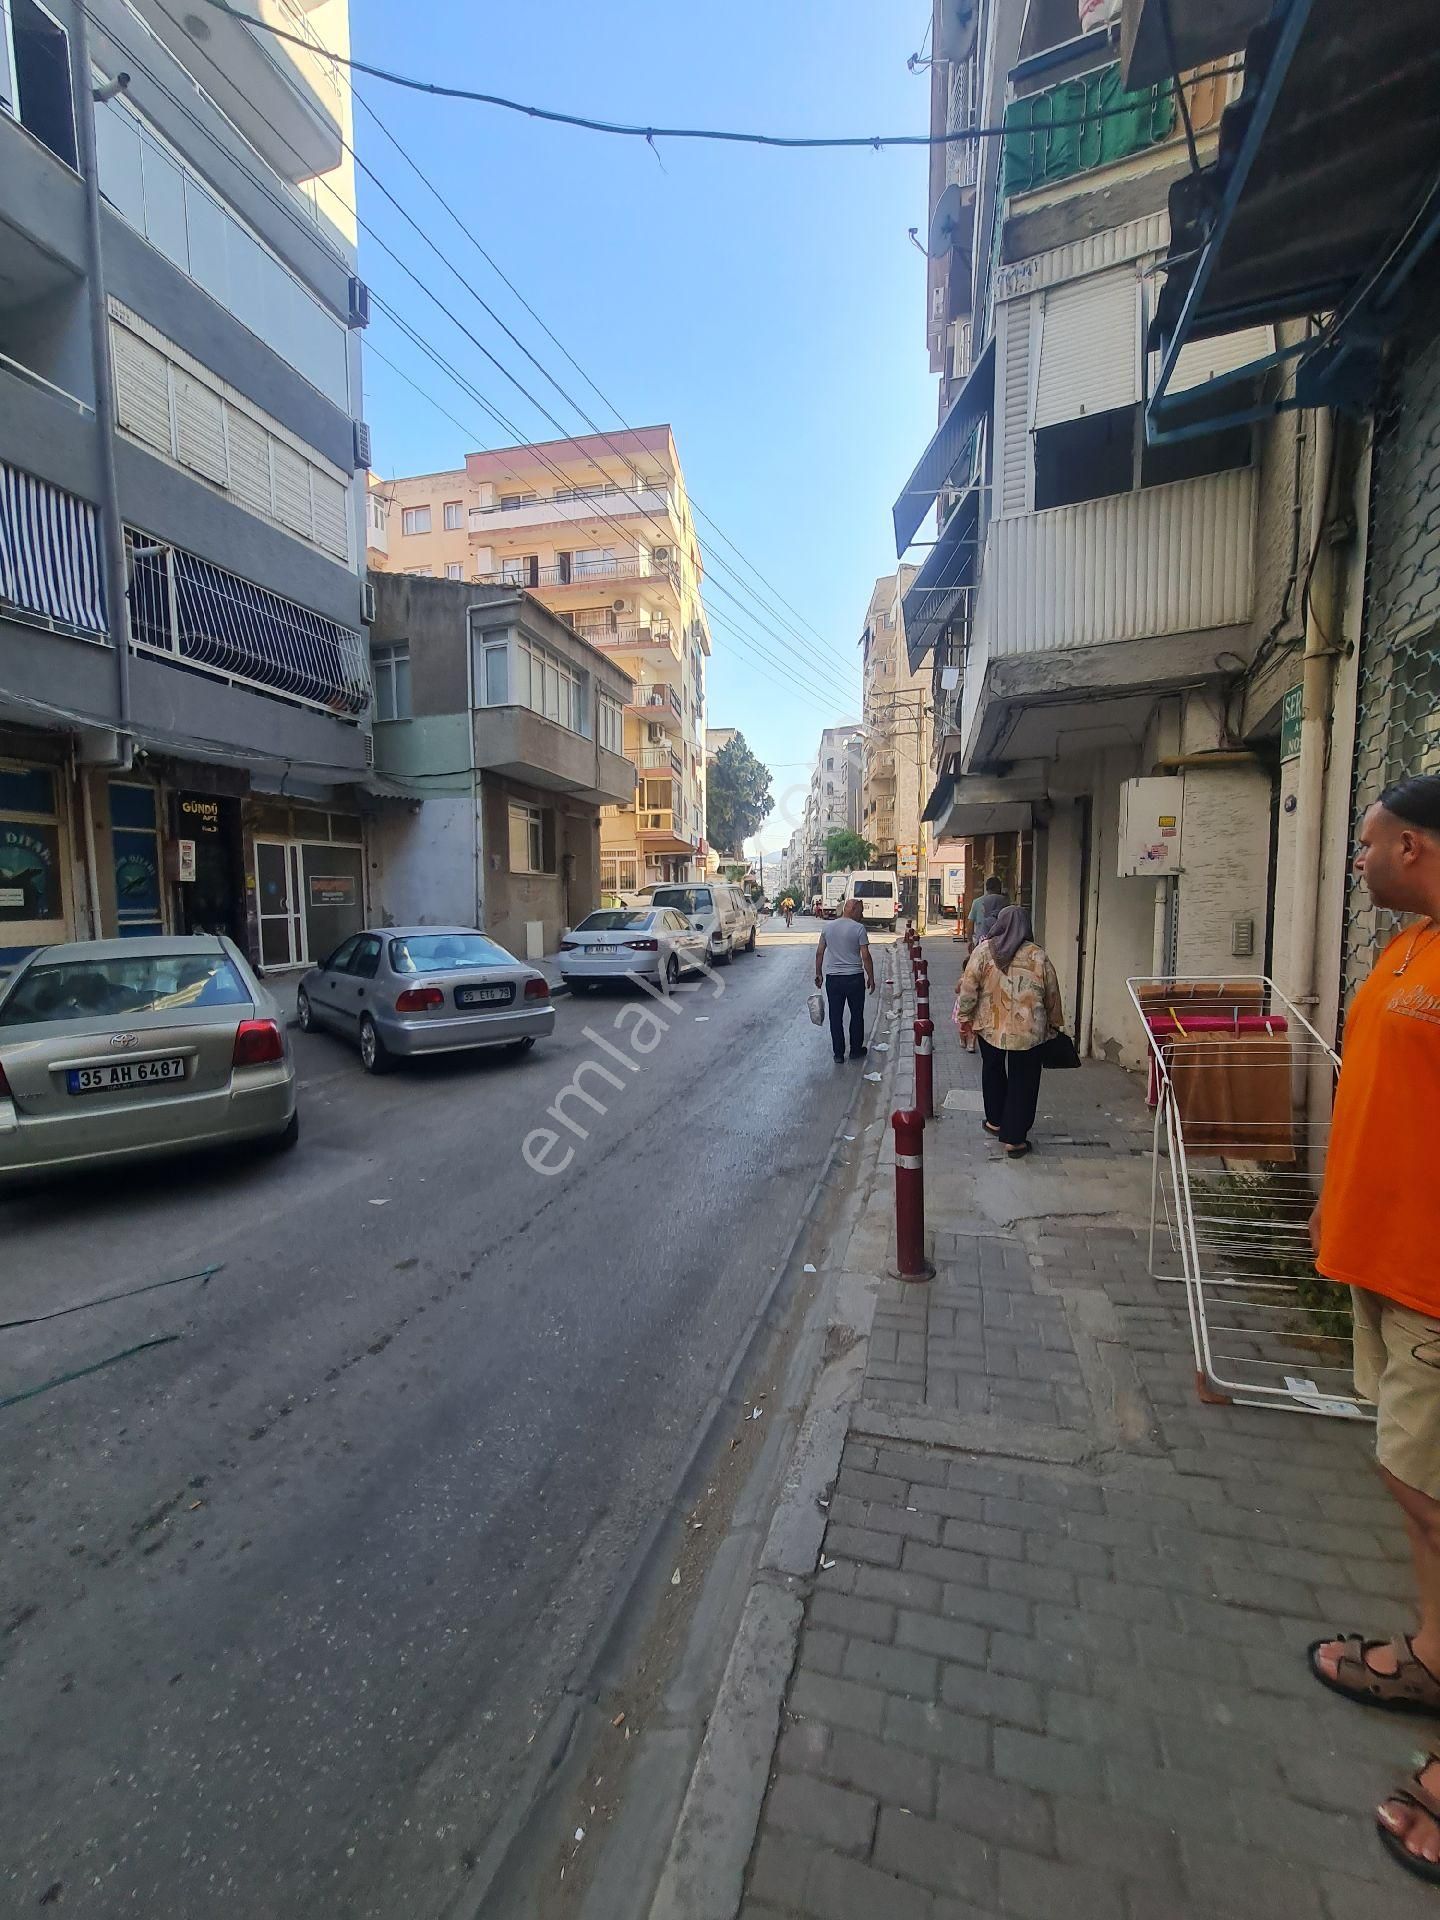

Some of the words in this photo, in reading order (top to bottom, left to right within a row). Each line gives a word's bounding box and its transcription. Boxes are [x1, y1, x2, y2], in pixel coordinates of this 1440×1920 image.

[464, 991, 474, 1001] 35
[80, 1070, 102, 1087] 35
[110, 1066, 132, 1083] AH
